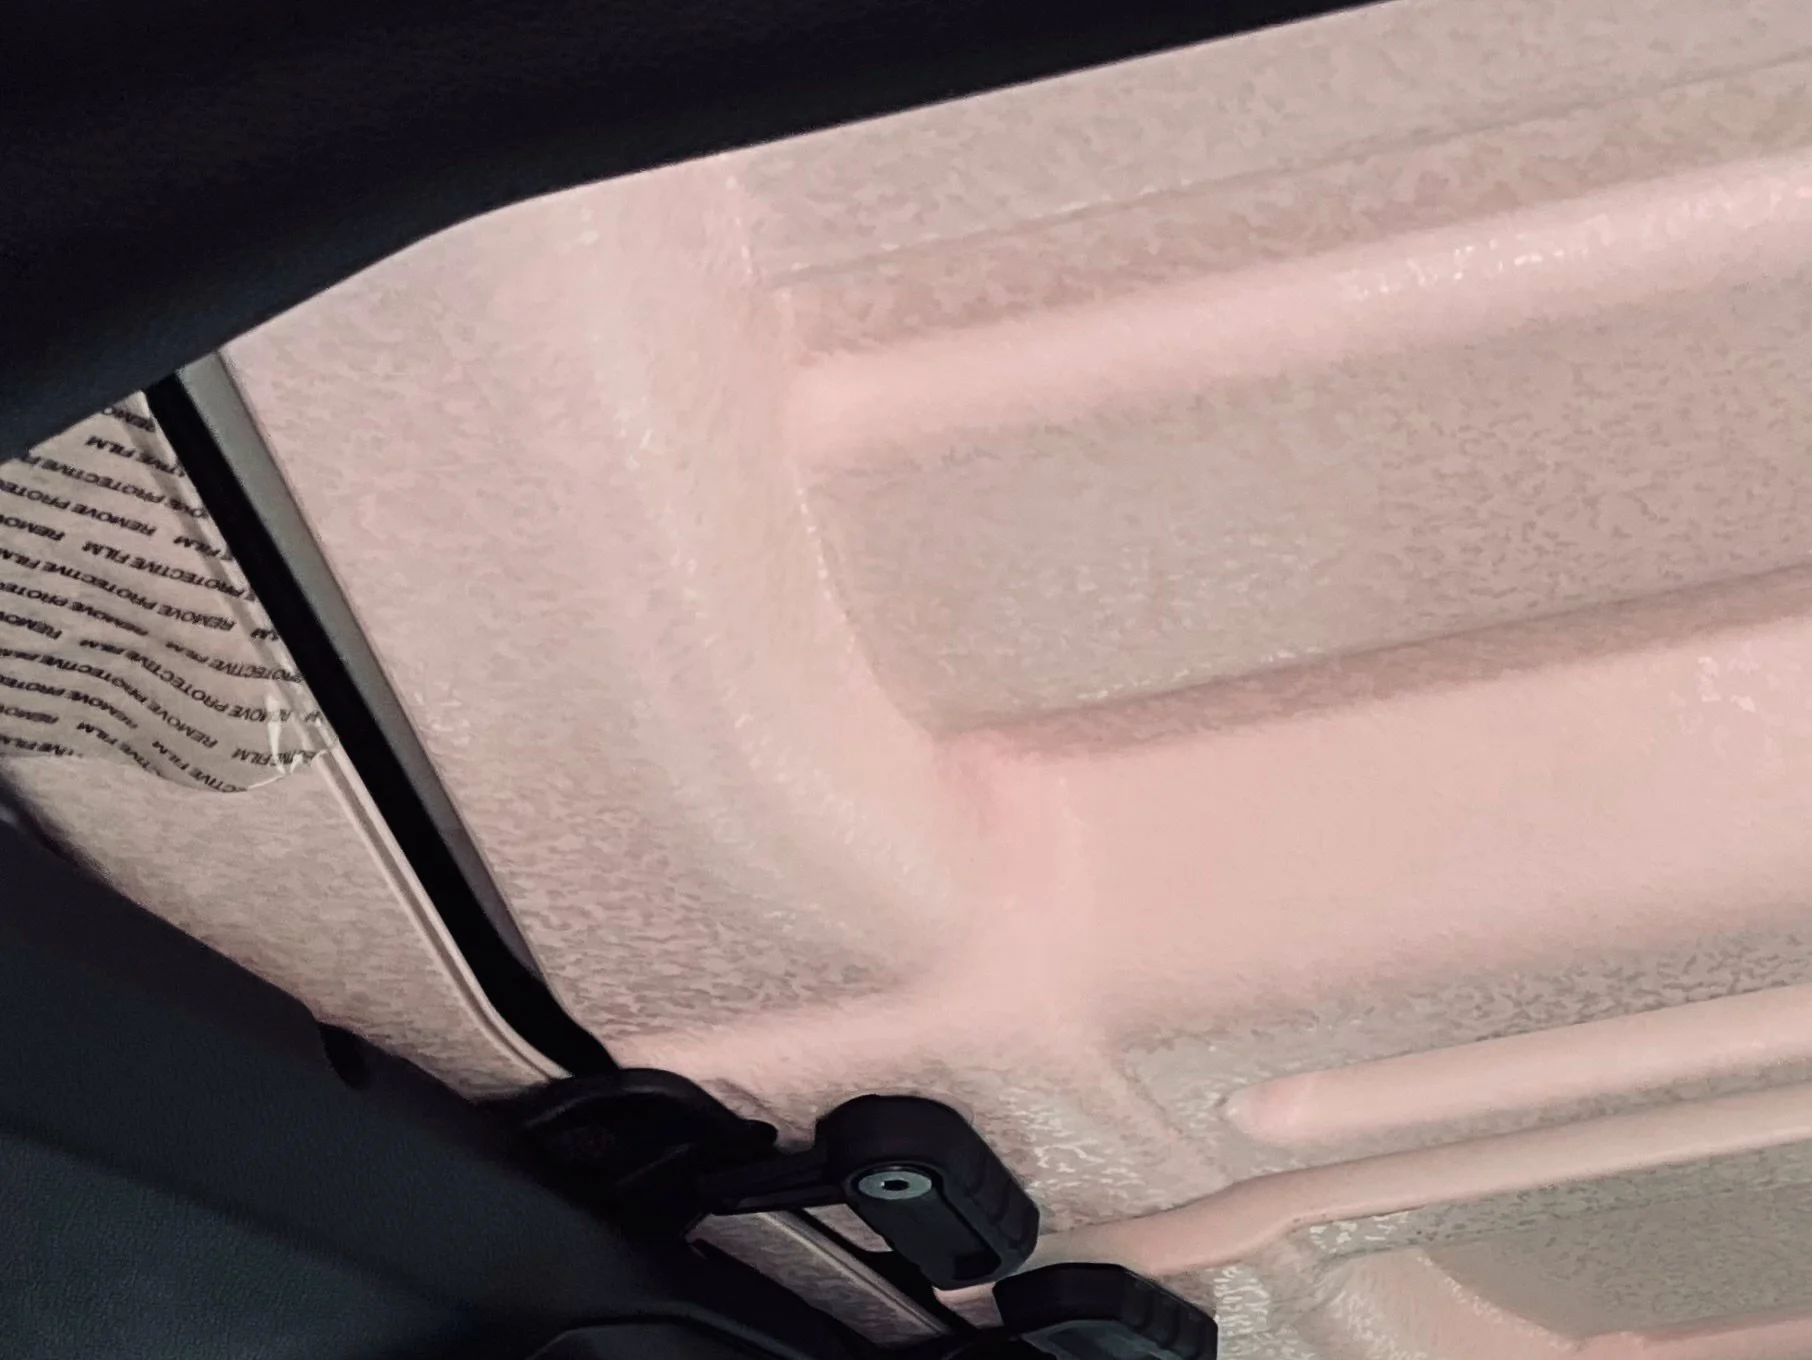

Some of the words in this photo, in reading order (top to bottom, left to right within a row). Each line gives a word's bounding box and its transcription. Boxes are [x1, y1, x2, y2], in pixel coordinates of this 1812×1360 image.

[84, 435, 136, 458] FILM
[41, 458, 165, 504] PROTECTIVE
[72, 503, 157, 537] REMOVE
[82, 541, 130, 564] FILM
[173, 536, 221, 556] FILM
[42, 562, 157, 610] PROTECTIVE
[130, 557, 245, 597] PROTECTIVE
[70, 601, 149, 636] REMOVE
[157, 604, 236, 631] REMOVE
[39, 655, 148, 704] PROTECTIVE
[124, 650, 230, 713] PROTECTIVE
[67, 691, 138, 729] REMOVE
[147, 700, 219, 748] REMOVE
[76, 722, 118, 745] FILM
[152, 740, 190, 771] FILM
